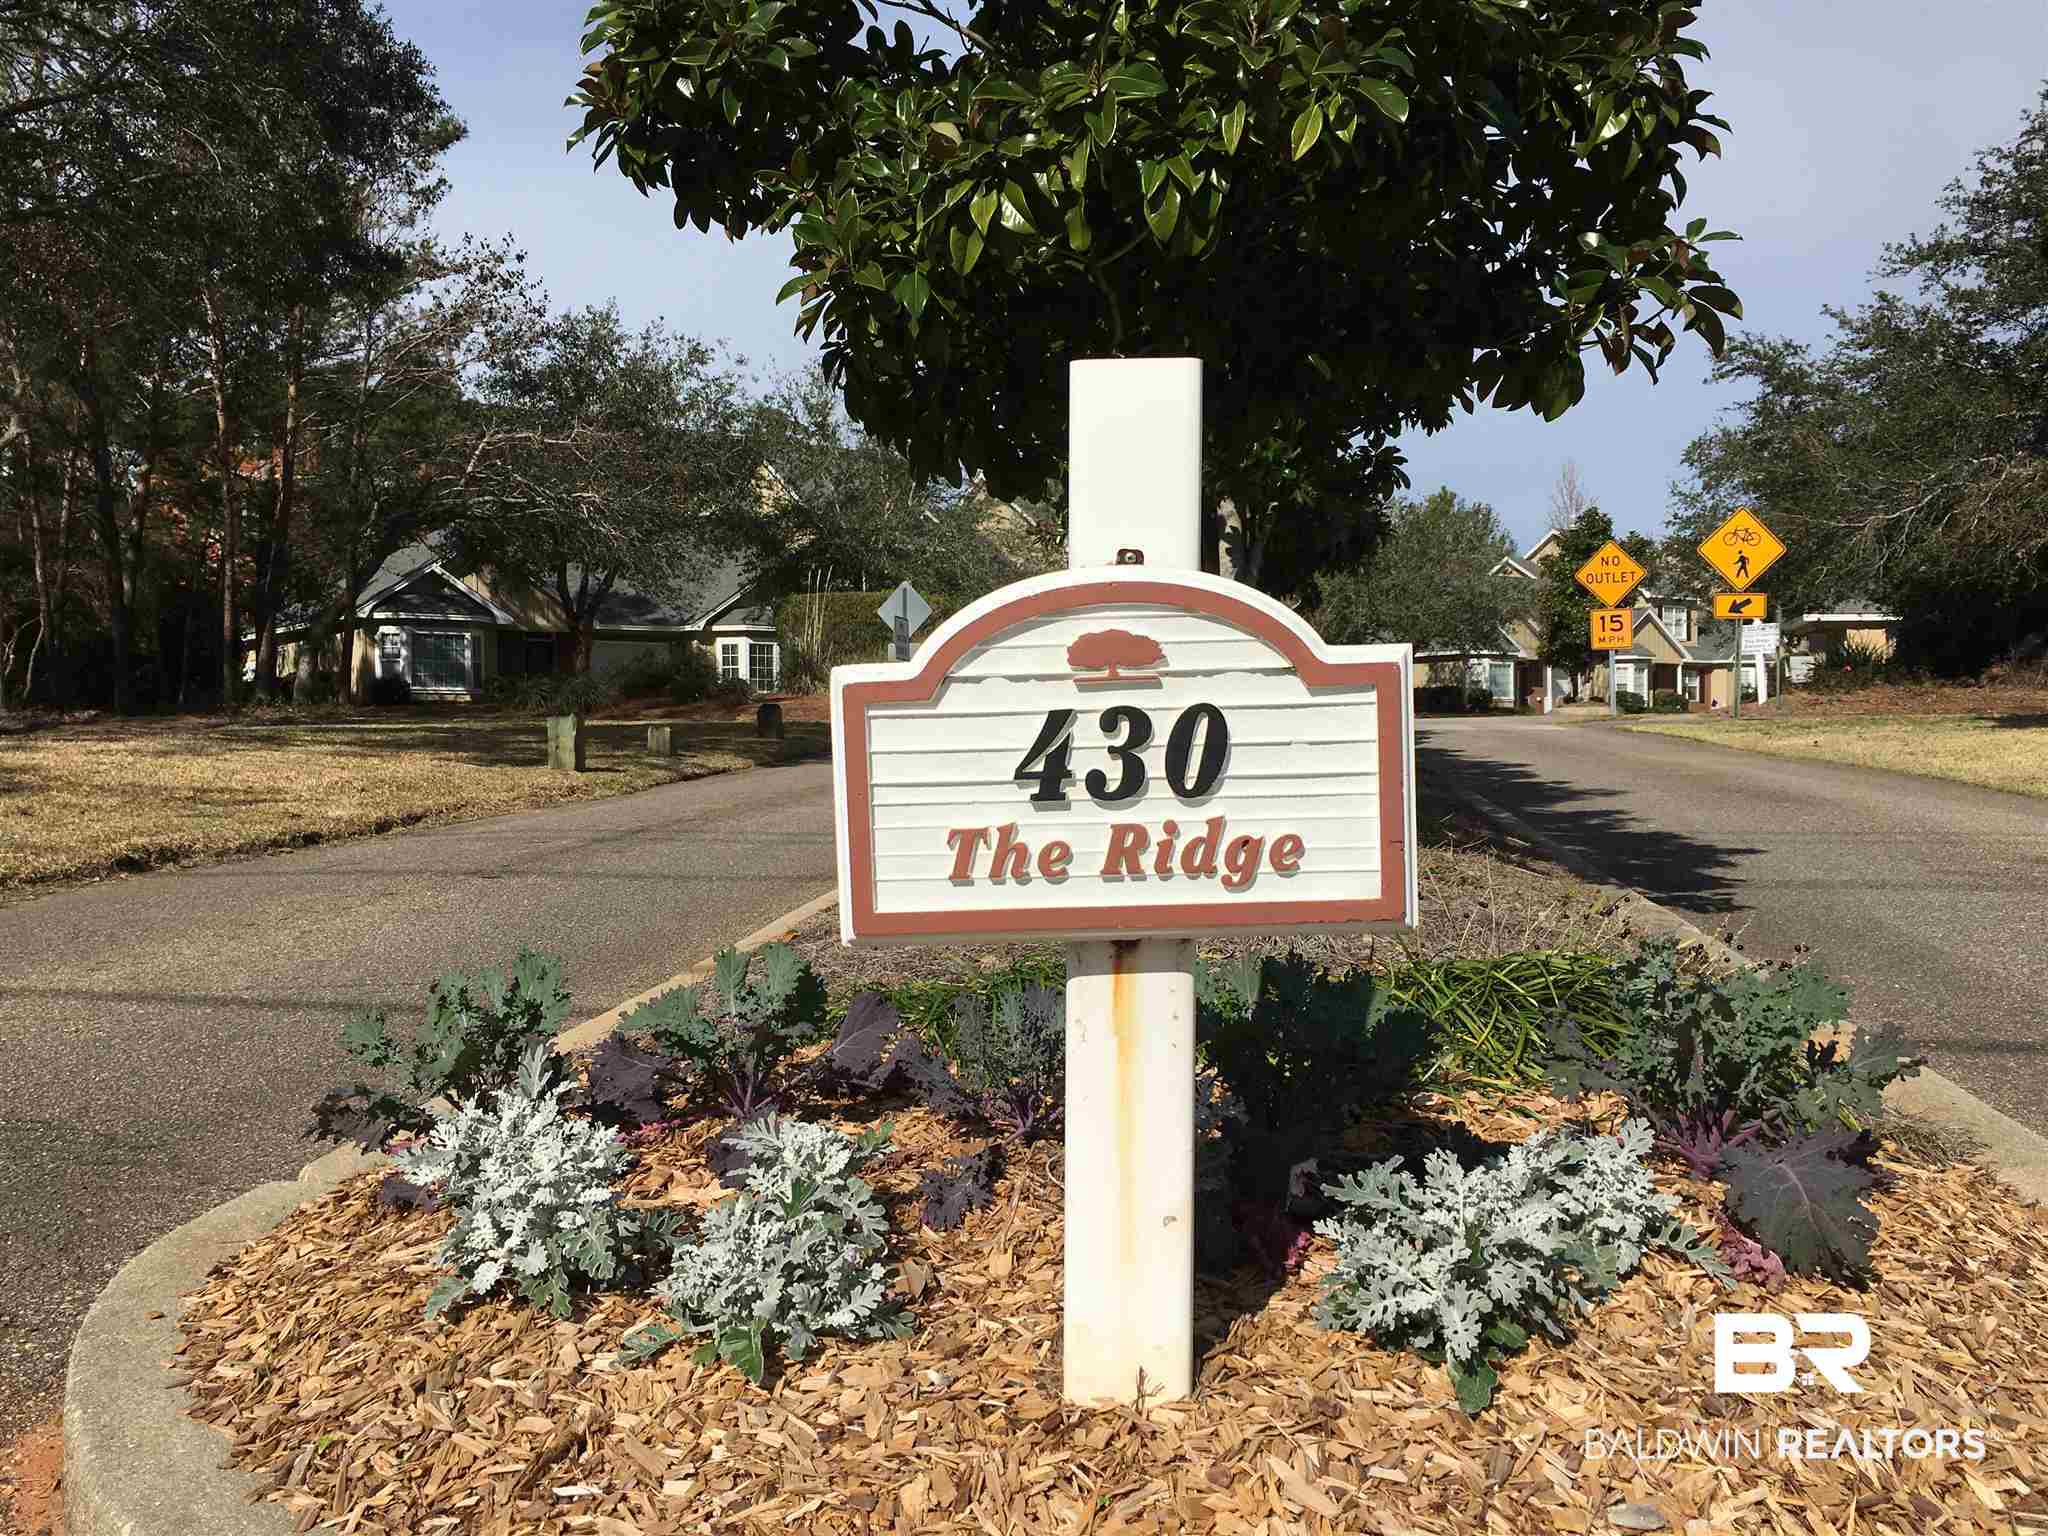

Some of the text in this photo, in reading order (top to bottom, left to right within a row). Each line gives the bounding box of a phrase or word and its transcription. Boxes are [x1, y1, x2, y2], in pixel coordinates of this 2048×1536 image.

[1600, 556, 1620, 567] NO
[1585, 571, 1637, 584] OUTLET
[1599, 614, 1624, 633] 15
[1598, 635, 1624, 645] MPH
[1014, 702, 1232, 806] 430
[946, 815, 1306, 892] The Ridge
